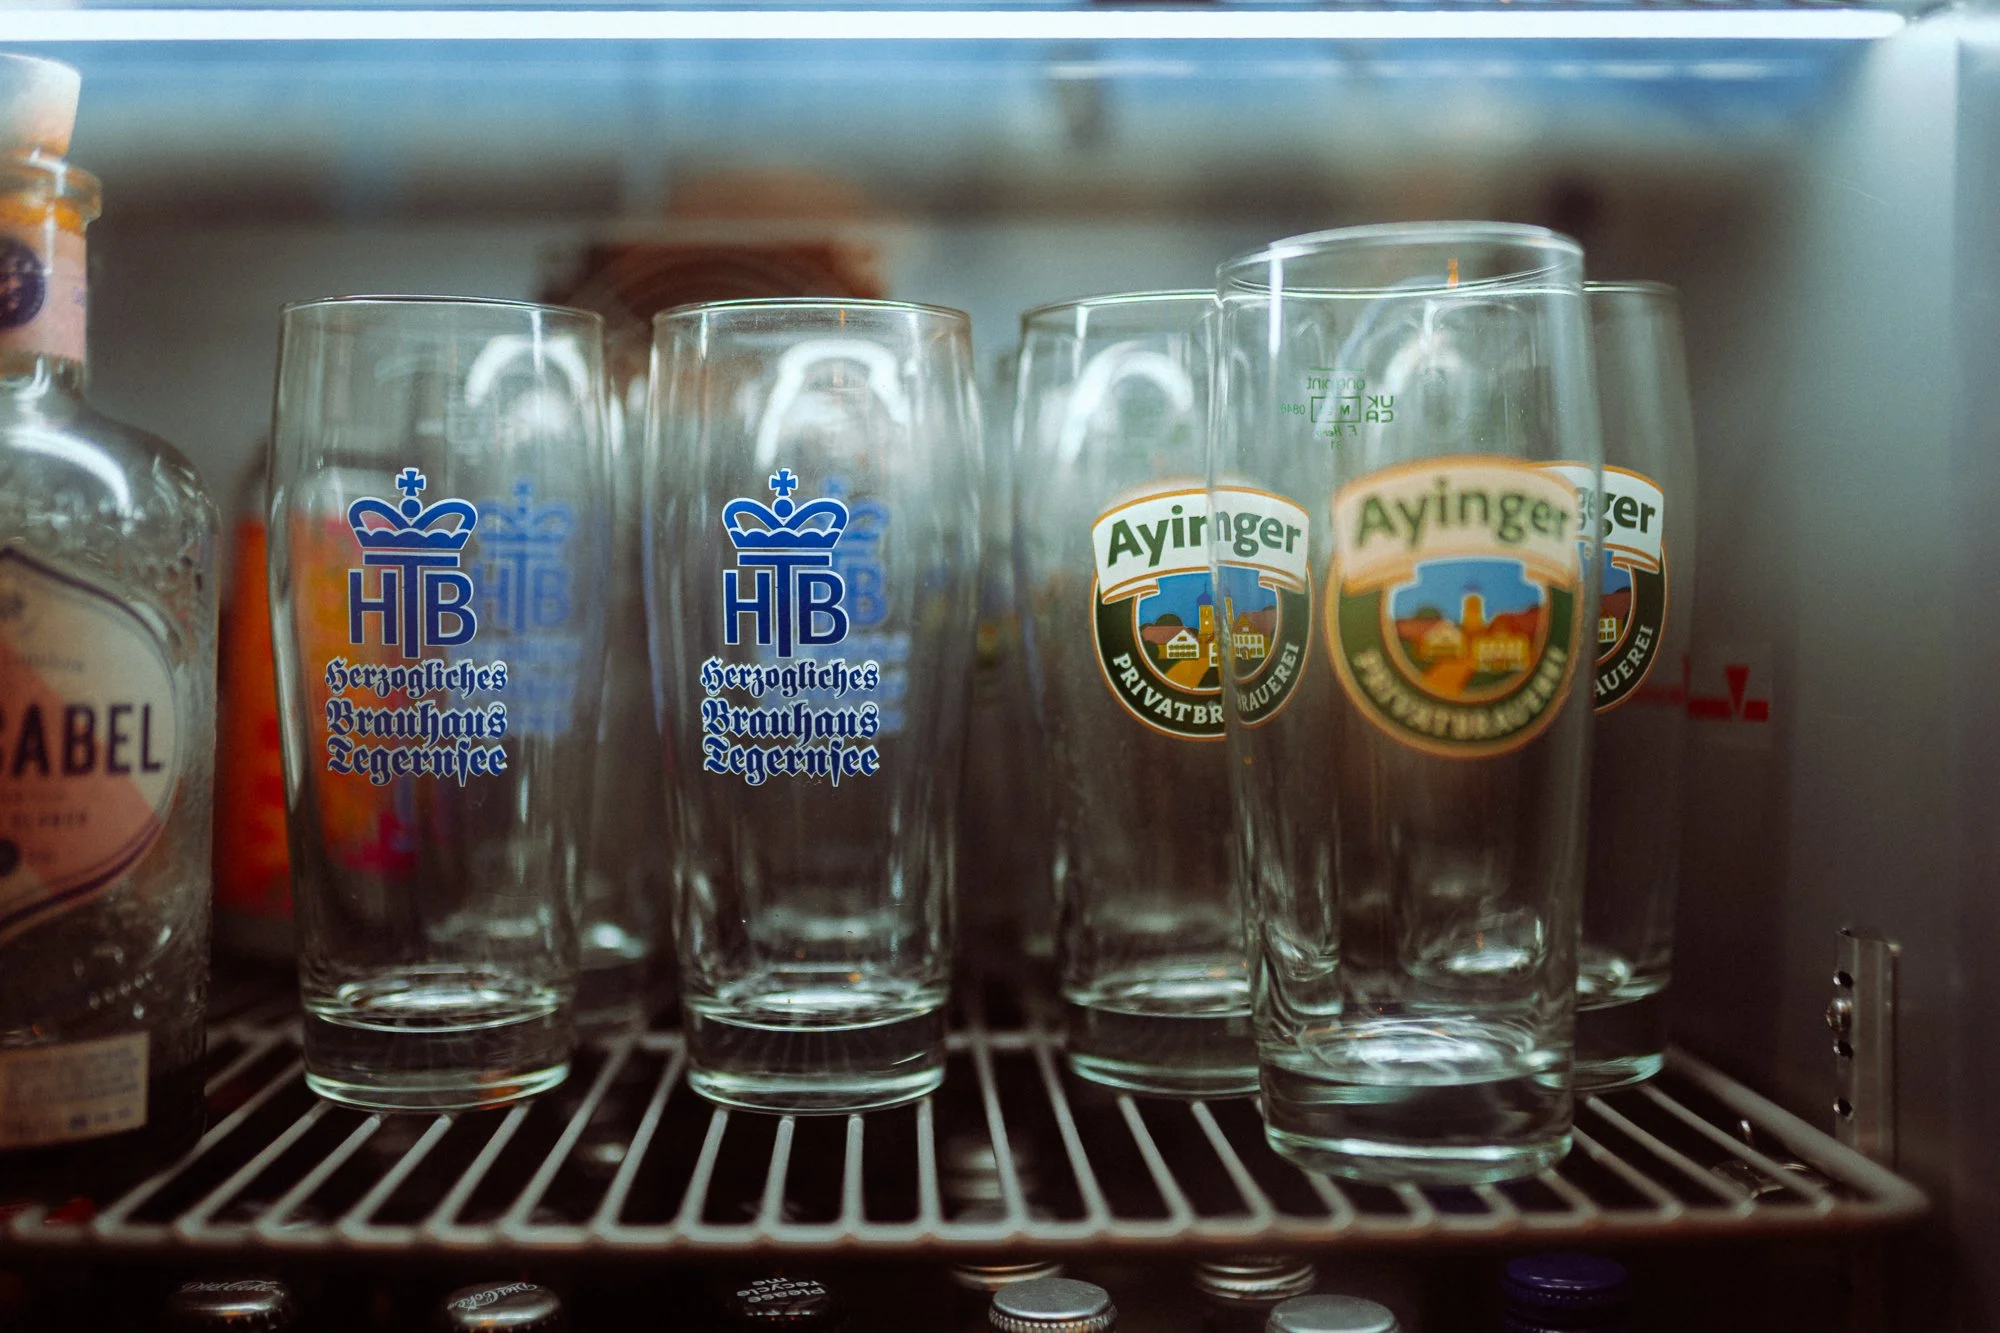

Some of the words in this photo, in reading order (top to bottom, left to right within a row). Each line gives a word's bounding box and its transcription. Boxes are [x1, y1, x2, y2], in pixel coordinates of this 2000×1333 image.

[1107, 504, 1302, 569] Ayinger
[1357, 474, 1568, 550] Ayinger
[347, 550, 478, 659] HTB
[722, 551, 850, 659] HTB
[325, 656, 508, 699] Herzogliches
[701, 656, 880, 698] Herzogliches
[0, 702, 163, 777] ABEL
[325, 697, 508, 748] Brauhaus
[701, 697, 881, 748] Brauhaus
[455, 1289, 500, 1312] Coke
[736, 1280, 821, 1297] recycle
[751, 1277, 788, 1286] me
